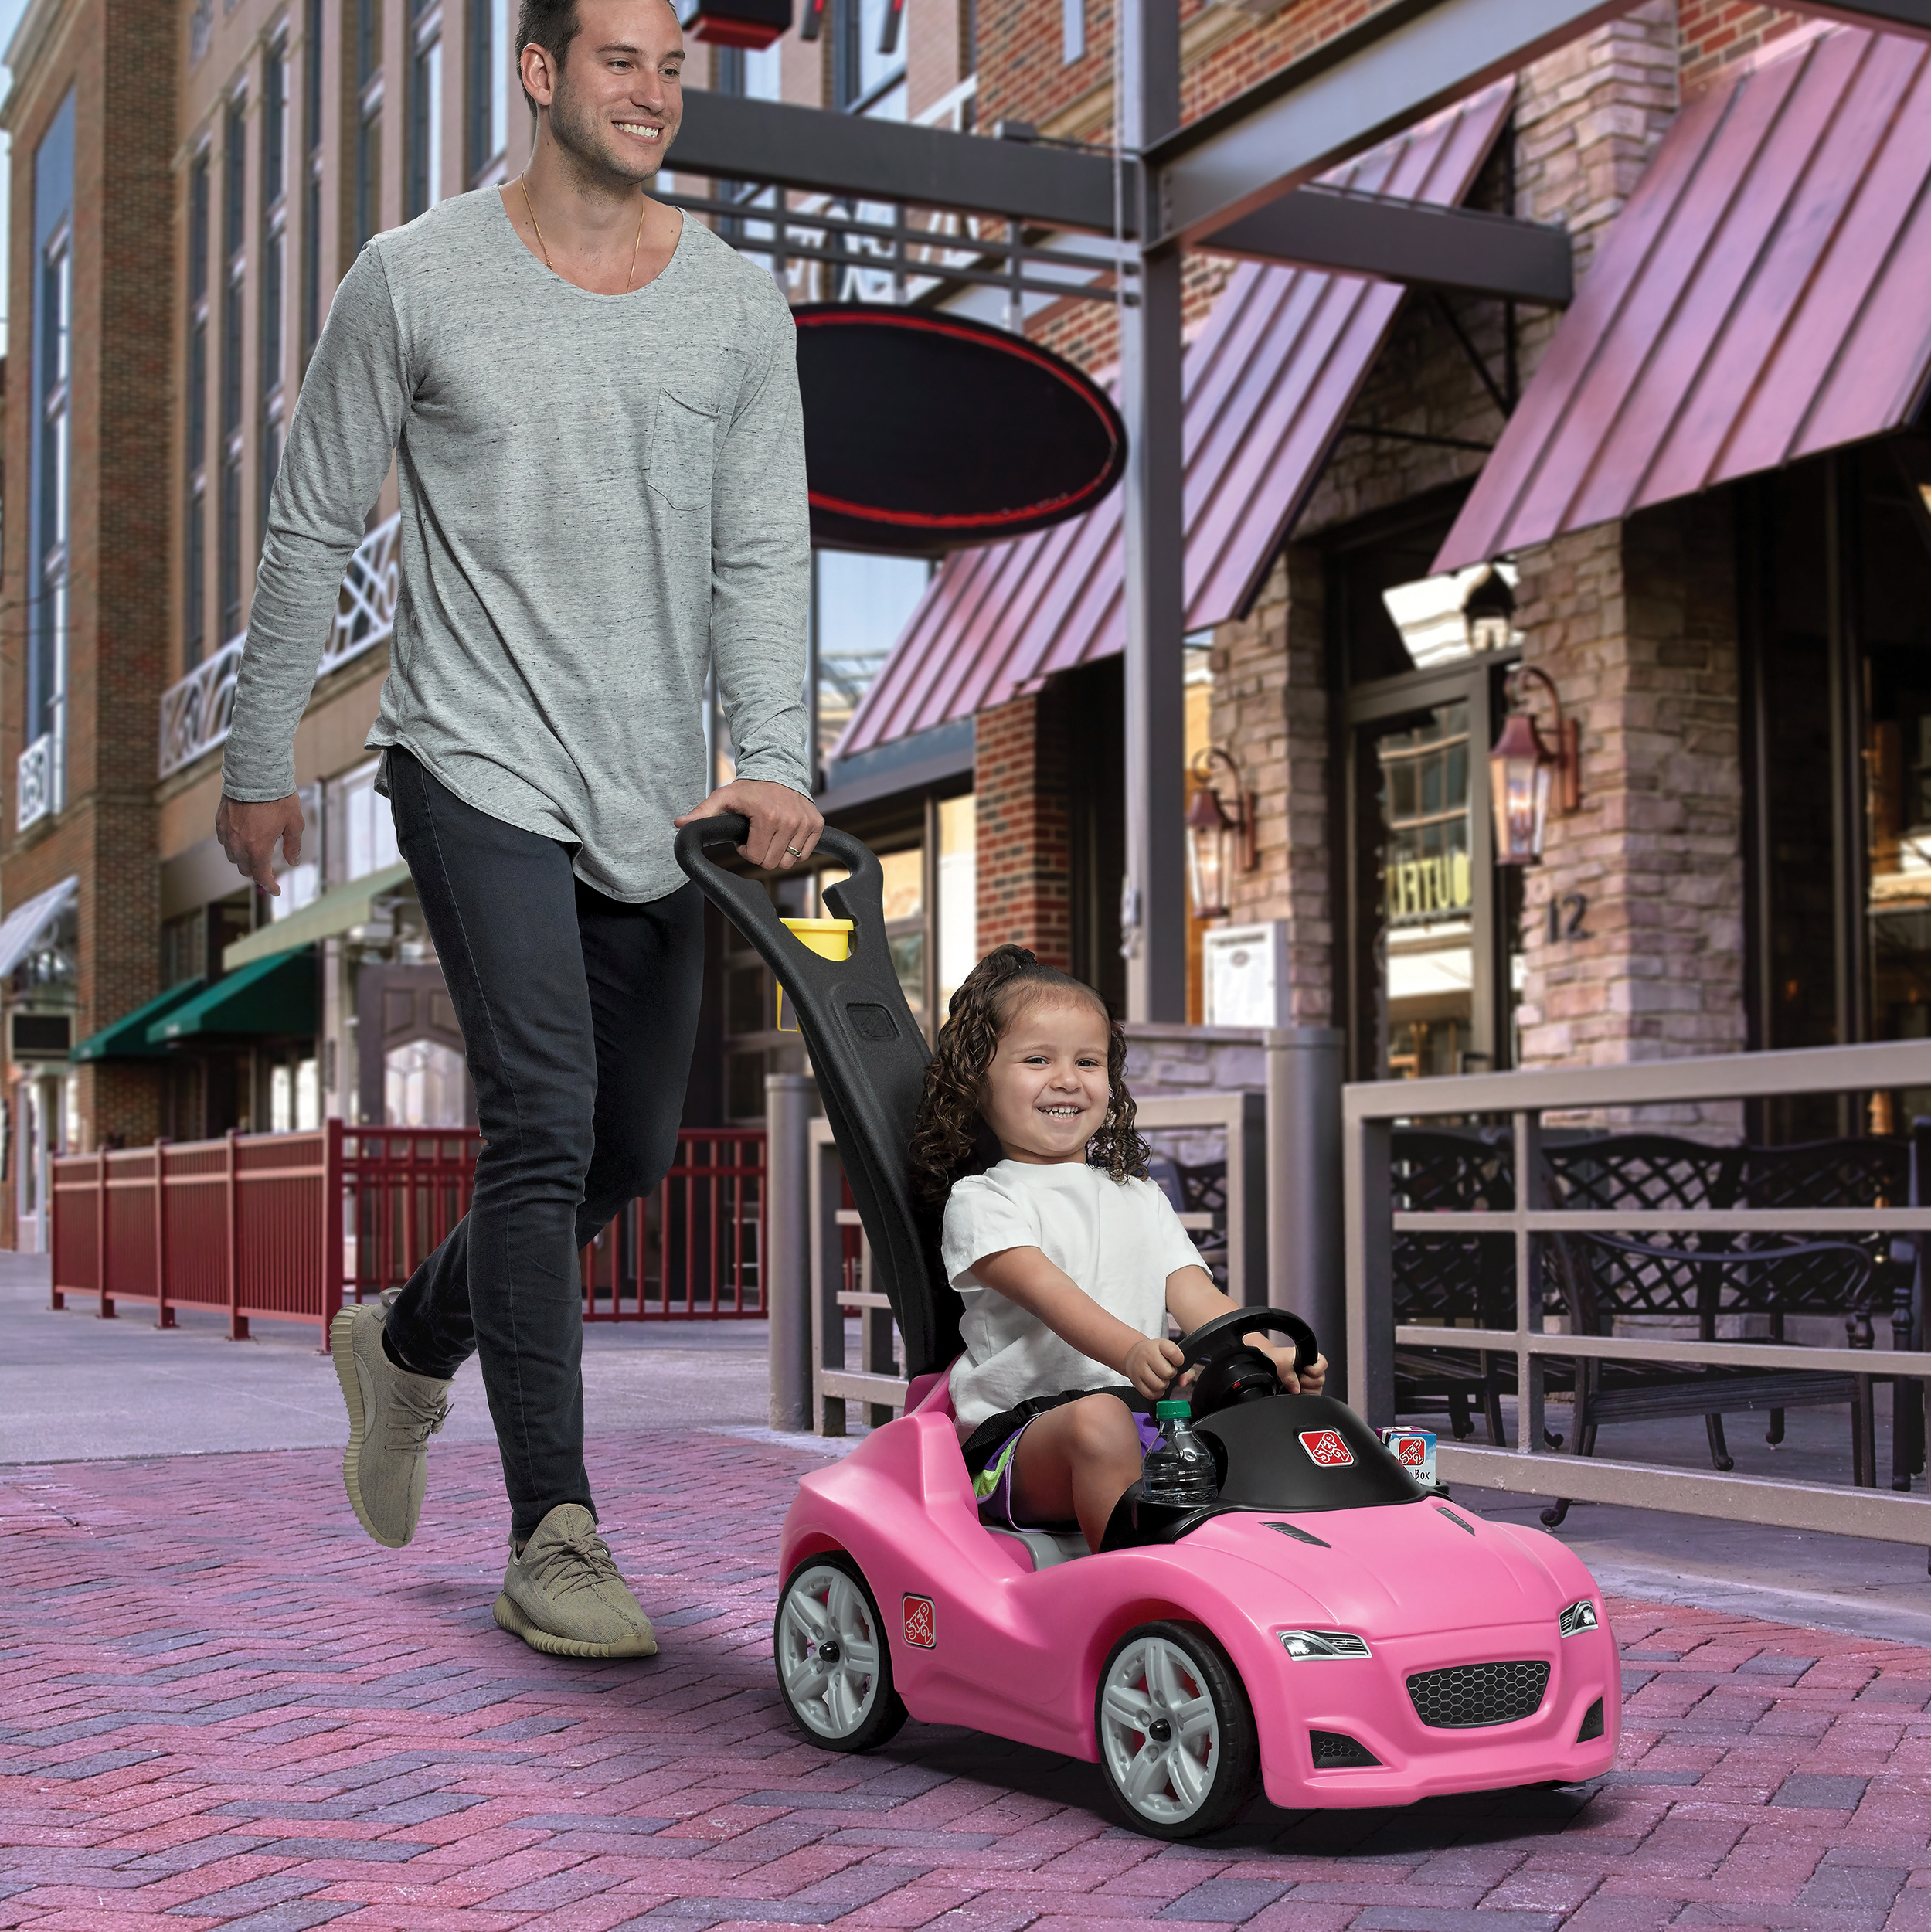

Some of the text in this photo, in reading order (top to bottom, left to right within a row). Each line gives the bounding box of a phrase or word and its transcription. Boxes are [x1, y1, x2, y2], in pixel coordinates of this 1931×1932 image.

[1549, 892, 1595, 944] 12
[1313, 1433, 1337, 1463] STEP
[1333, 1448, 1350, 1462] 2
[1399, 1439, 1421, 1464] STEP
[1413, 1454, 1424, 1465] 2
[906, 1602, 929, 1640] STEP
[921, 1624, 933, 1644] 2
